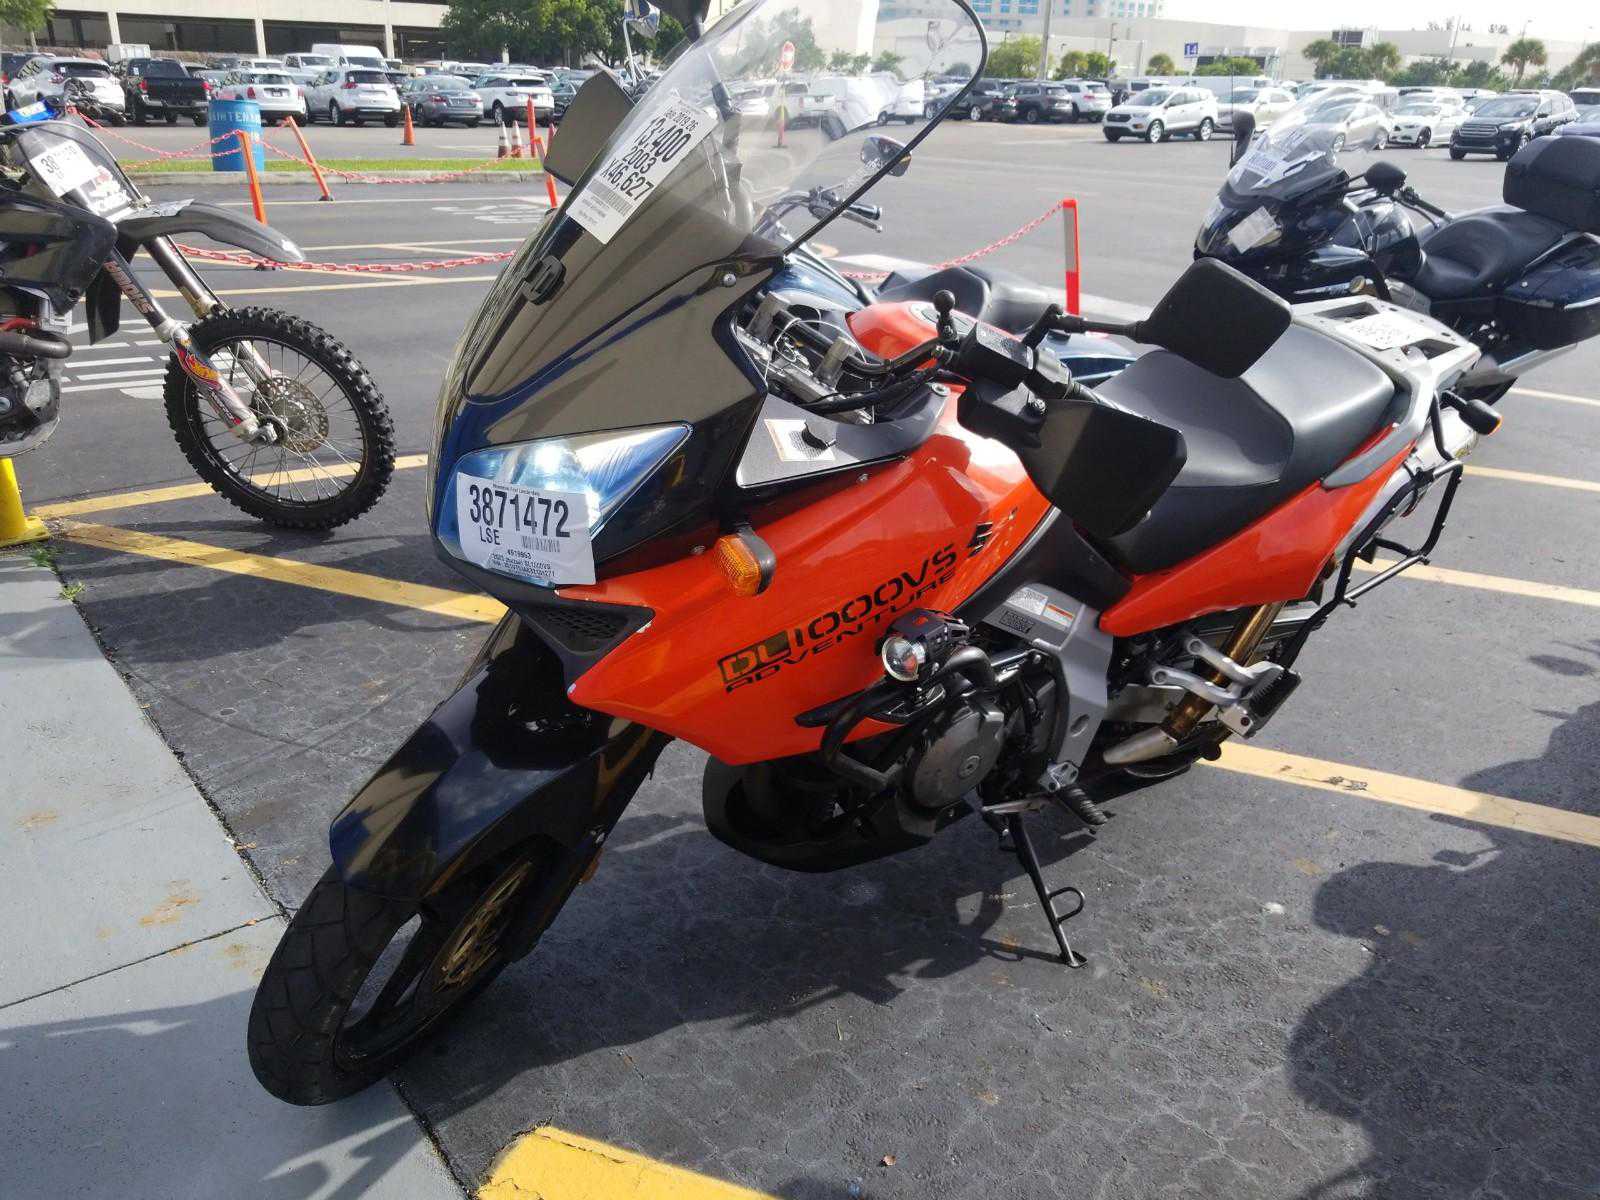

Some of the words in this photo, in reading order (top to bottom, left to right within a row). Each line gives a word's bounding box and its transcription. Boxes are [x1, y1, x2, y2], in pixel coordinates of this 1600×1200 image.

[623, 146, 657, 174] 2003
[469, 484, 570, 538] 3871472
[480, 525, 501, 546] LSE
[725, 567, 957, 694] ADVENTURE
